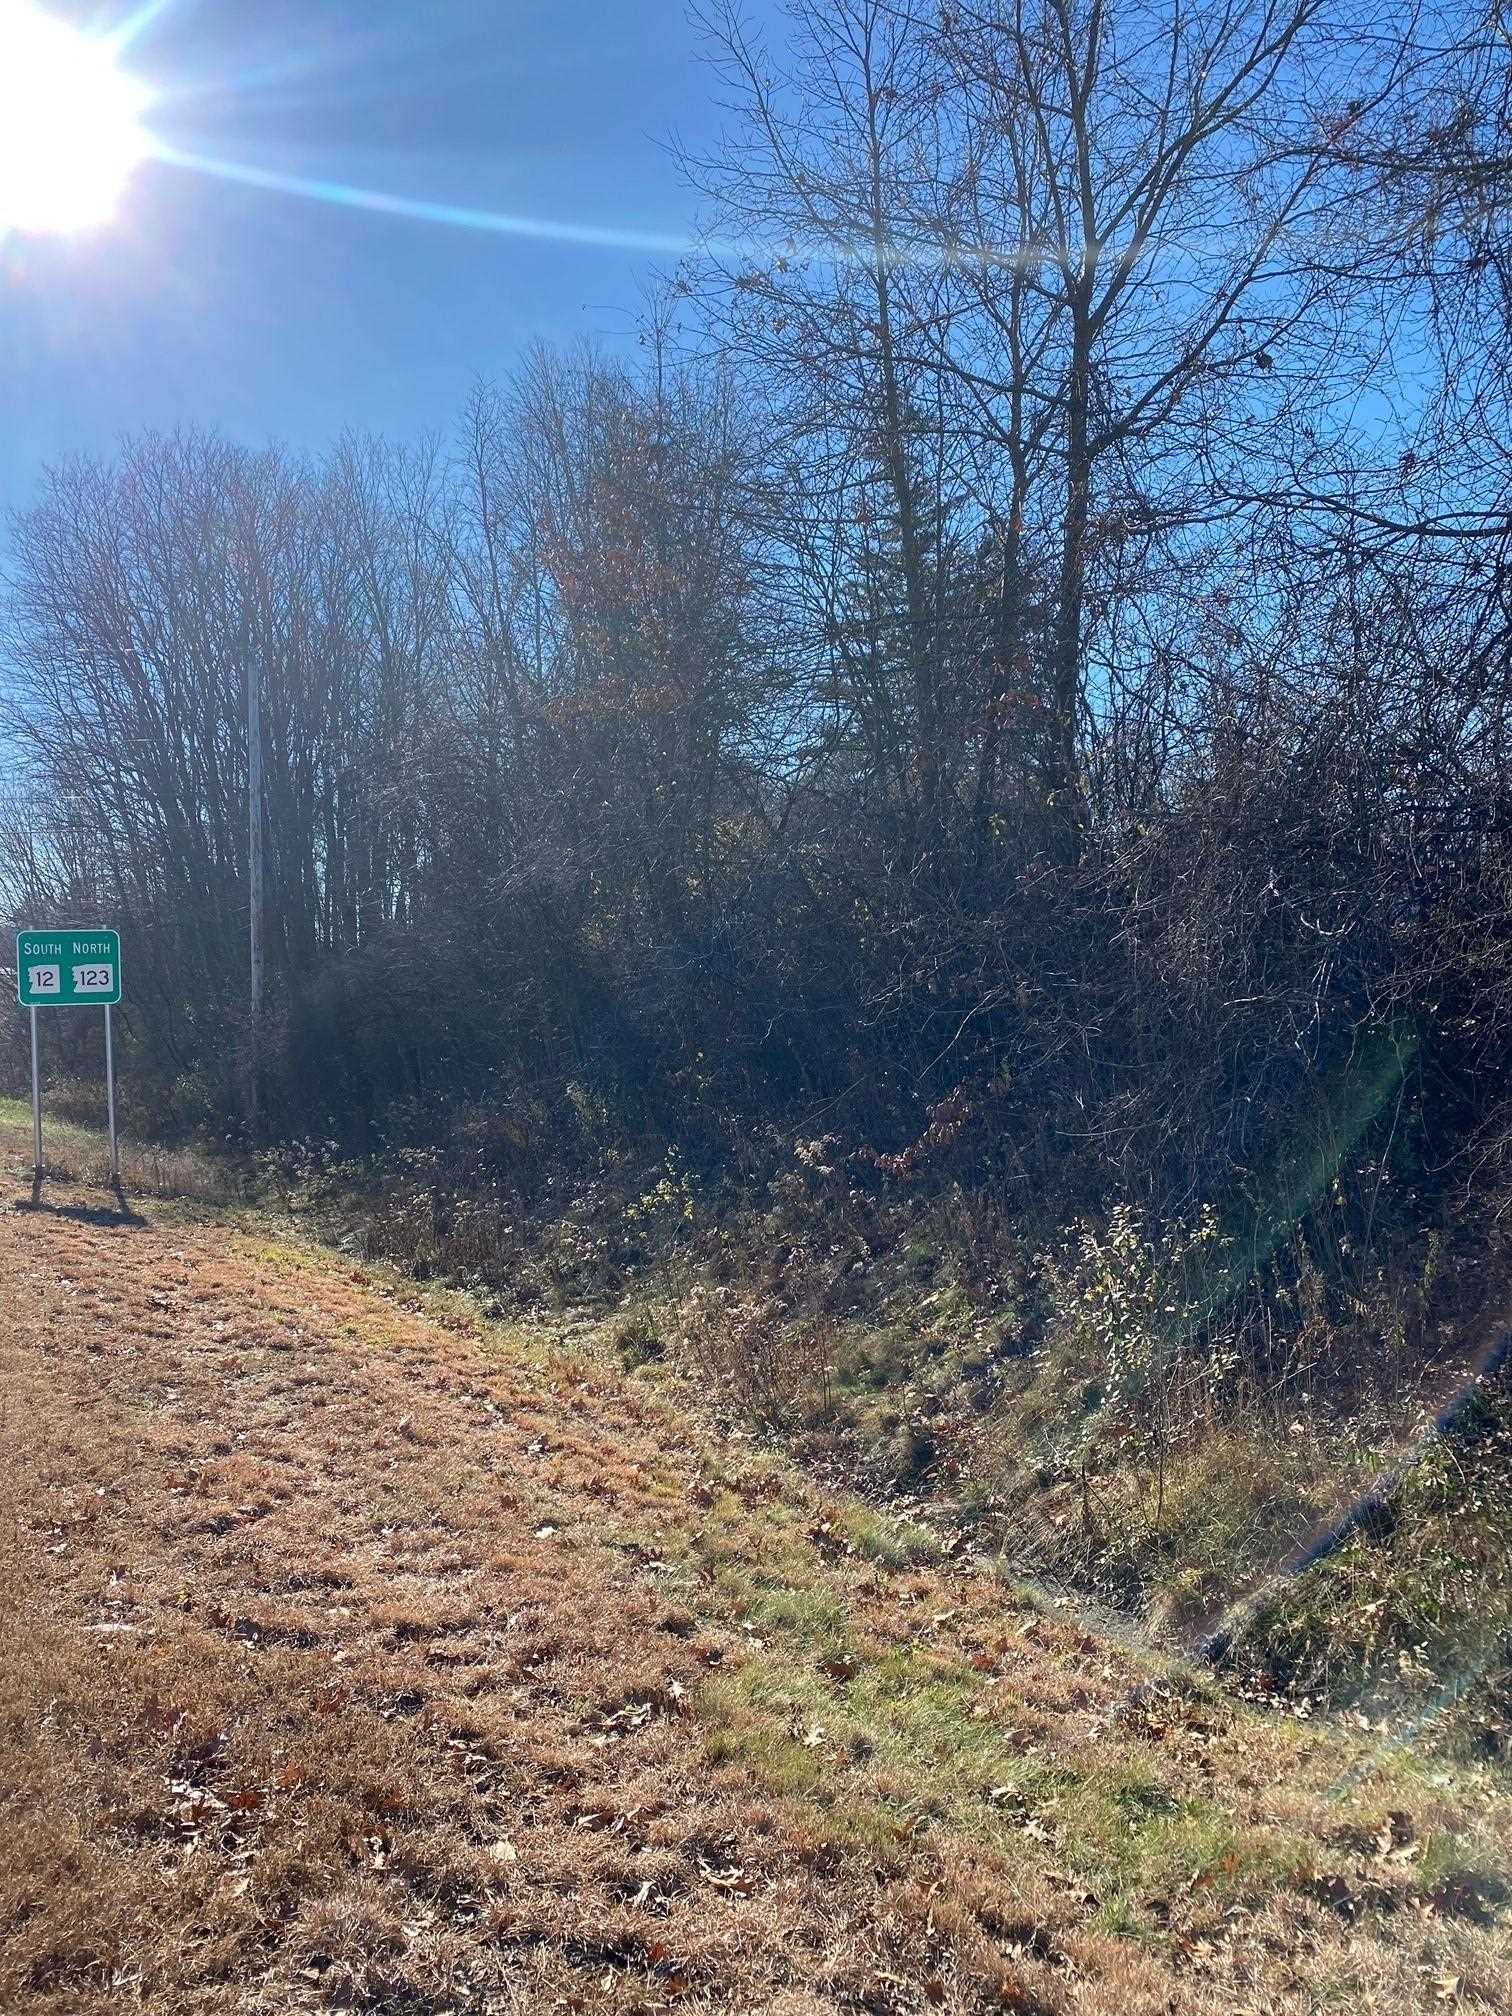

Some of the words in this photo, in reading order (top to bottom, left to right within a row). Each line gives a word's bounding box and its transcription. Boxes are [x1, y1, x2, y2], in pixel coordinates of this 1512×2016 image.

[24, 943, 61, 955] SOUTH
[73, 942, 110, 954] NORTH
[36, 971, 54, 987] 12
[80, 970, 109, 986] 123
